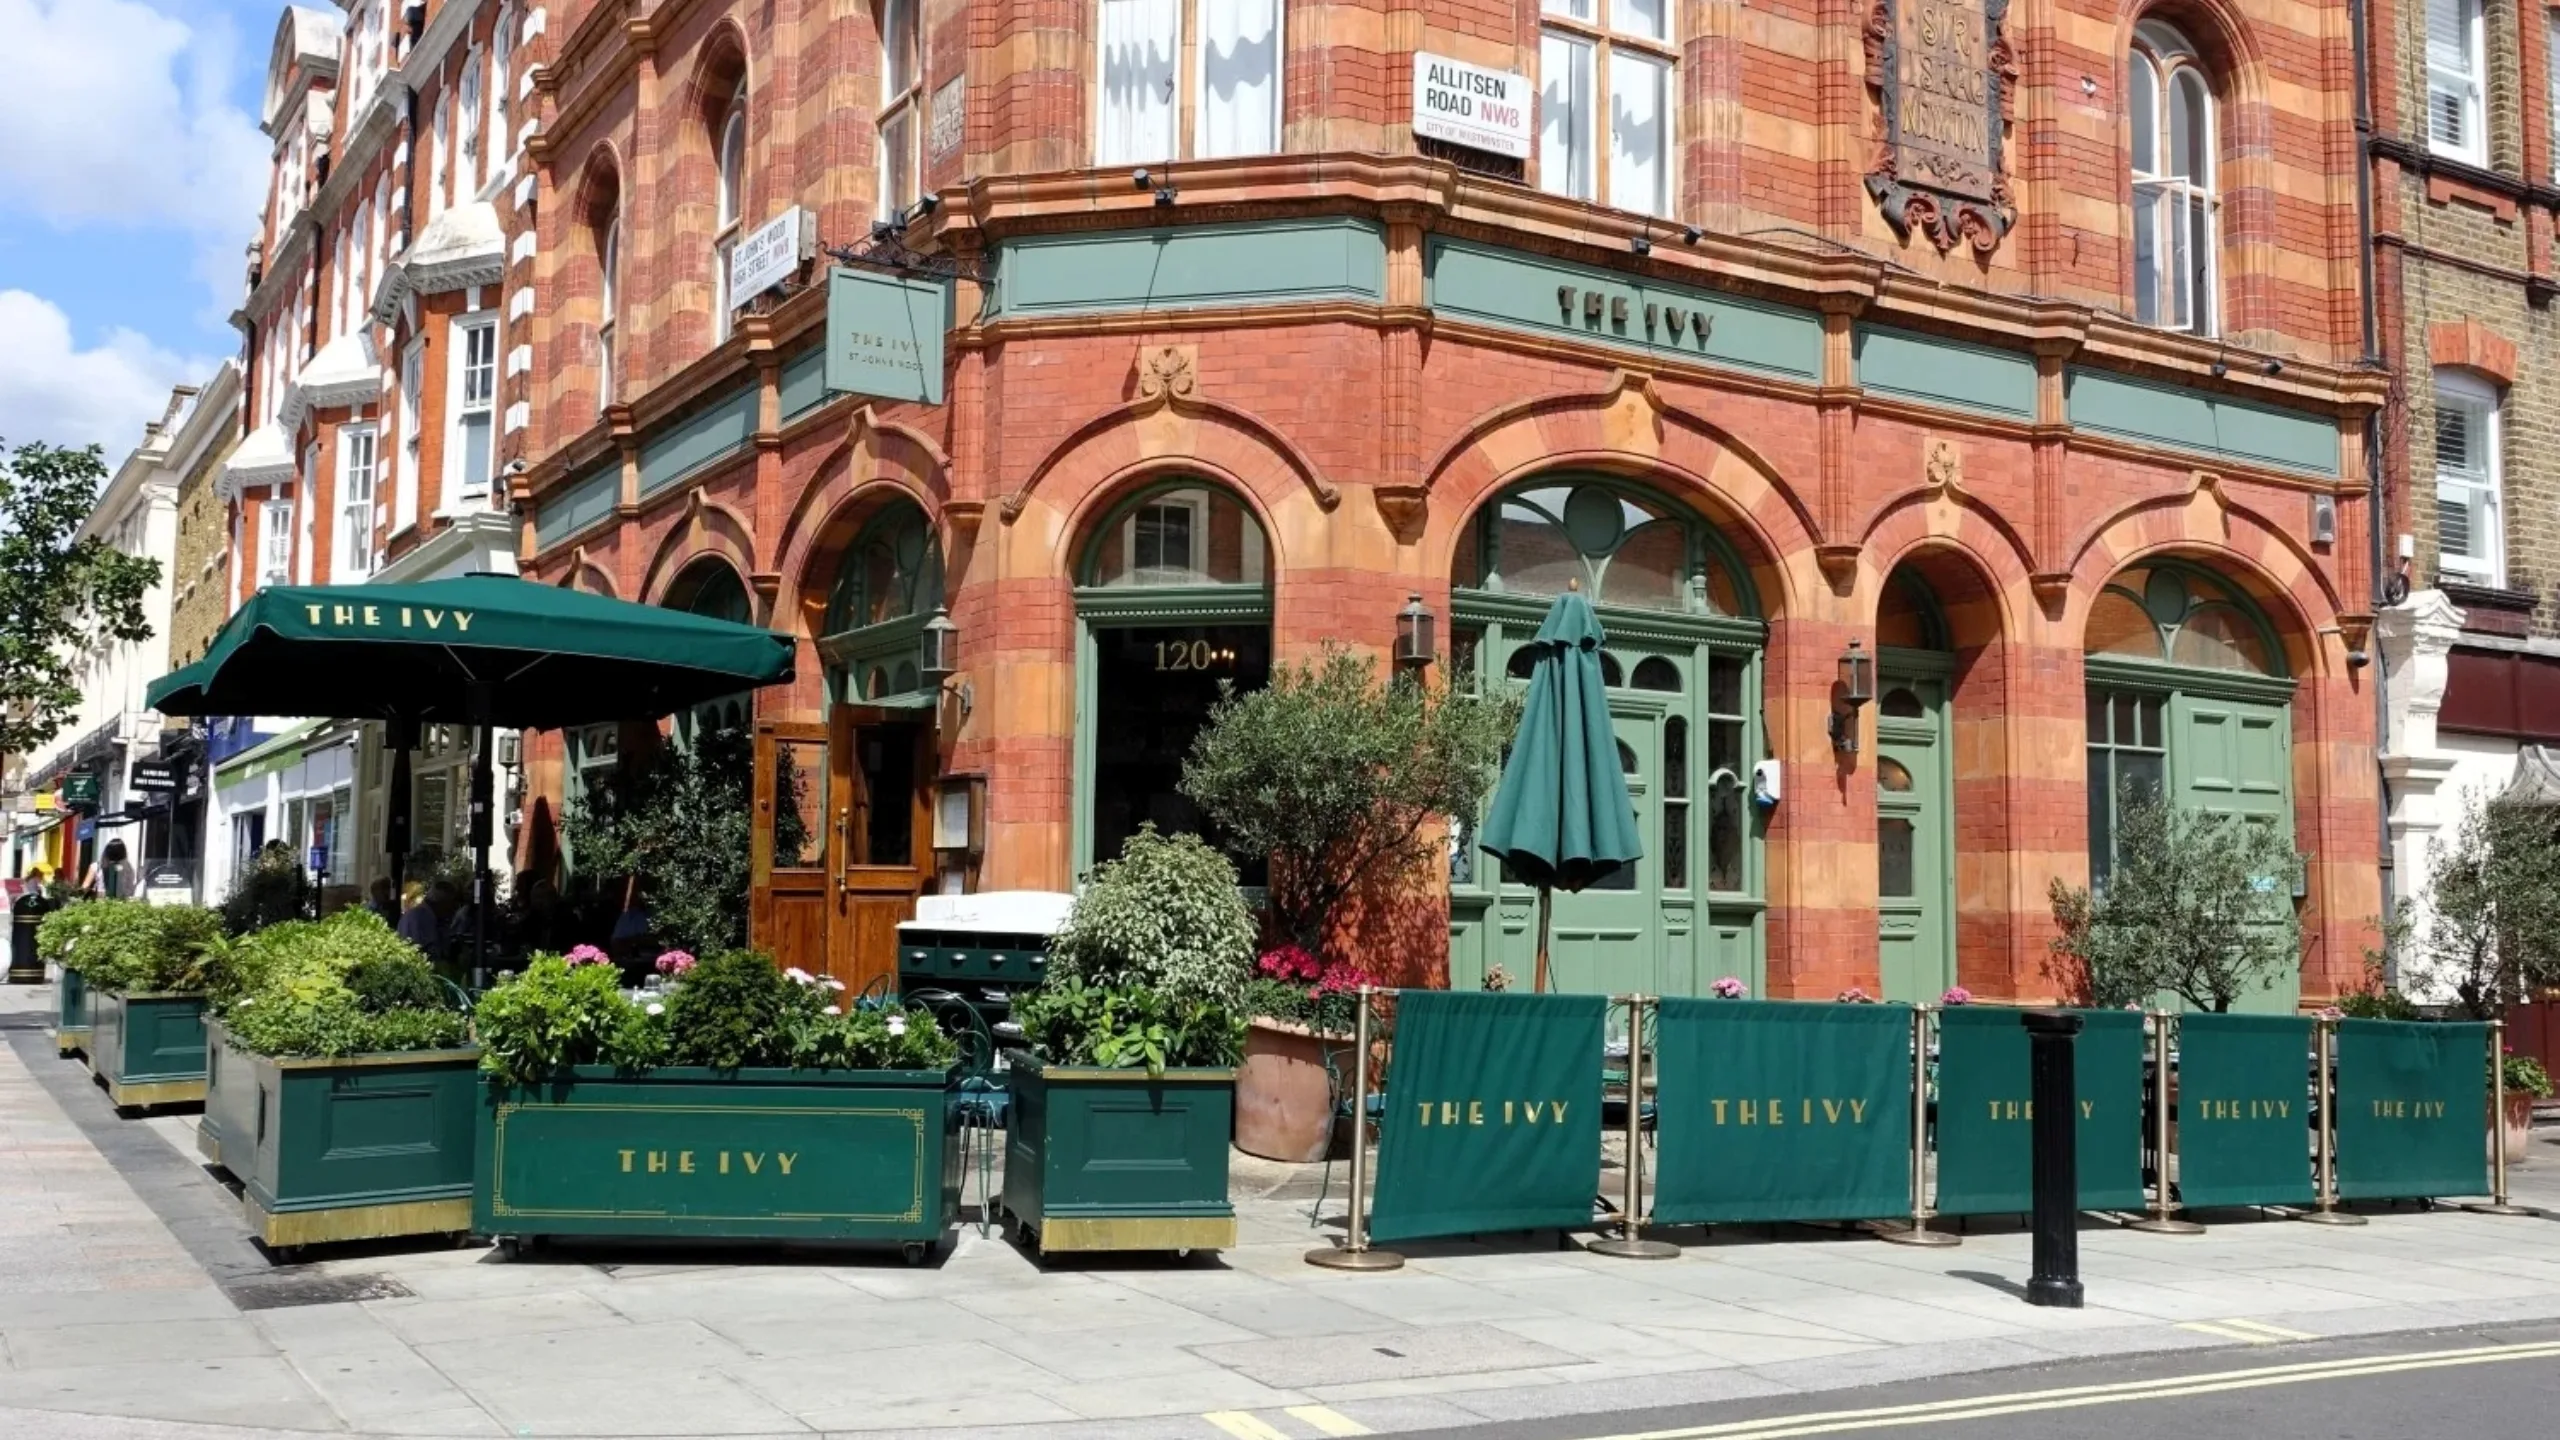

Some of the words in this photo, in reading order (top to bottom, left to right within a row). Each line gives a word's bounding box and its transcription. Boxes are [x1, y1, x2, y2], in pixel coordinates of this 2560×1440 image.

[1922, 7, 1970, 57] SIR
[1427, 63, 1506, 100] ALLITSEN
[1426, 87, 1472, 117] ROAD
[1480, 101, 1520, 128] NW8
[1426, 122, 1443, 134] CITY
[1445, 126, 1454, 137] OF
[1458, 128, 1515, 151] WESTMINSTER
[748, 249, 770, 278] STREET
[1558, 285, 1628, 322] THE
[1645, 303, 1714, 336] IVY
[851, 332, 883, 348] THE
[305, 604, 380, 625] THE
[402, 607, 474, 631] IVY
[1155, 640, 1211, 670] 120
[1418, 1101, 1484, 1126] THE
[1505, 1101, 1569, 1124] IVY
[1711, 1099, 1784, 1125] THE
[1803, 1098, 1868, 1124] IVY
[2200, 1100, 2241, 1119] THE
[2252, 1100, 2290, 1119] IVY
[2372, 1100, 2404, 1118] THE
[2414, 1101, 2444, 1118] IVY
[618, 1150, 695, 1173] THE
[720, 1152, 798, 1174] IVY
